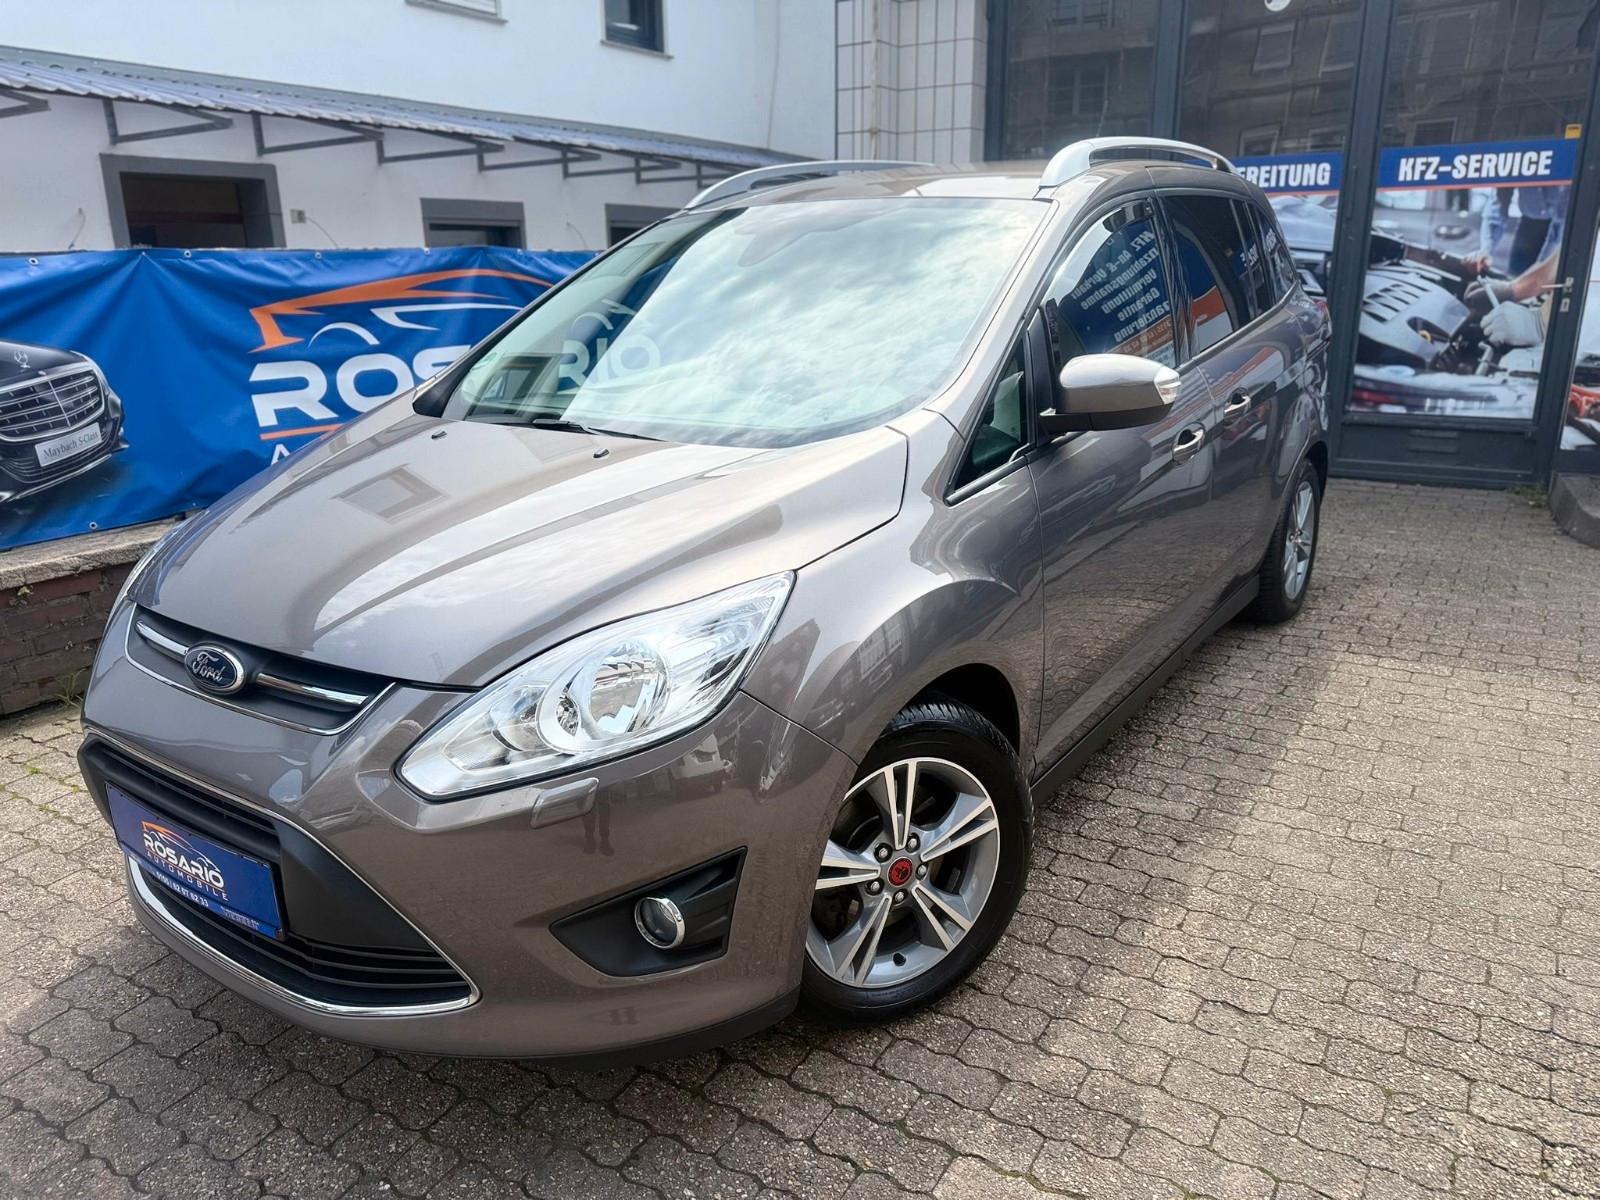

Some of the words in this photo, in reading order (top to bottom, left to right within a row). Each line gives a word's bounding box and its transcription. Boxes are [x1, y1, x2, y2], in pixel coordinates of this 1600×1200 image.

[1397, 150, 1554, 182] KFZ-SERVICE
[42, 441, 78, 460] Maybach
[192, 651, 226, 682] Ford
[143, 832, 226, 889] ROSARIO
[147, 850, 229, 901] AUTOMOBILE
